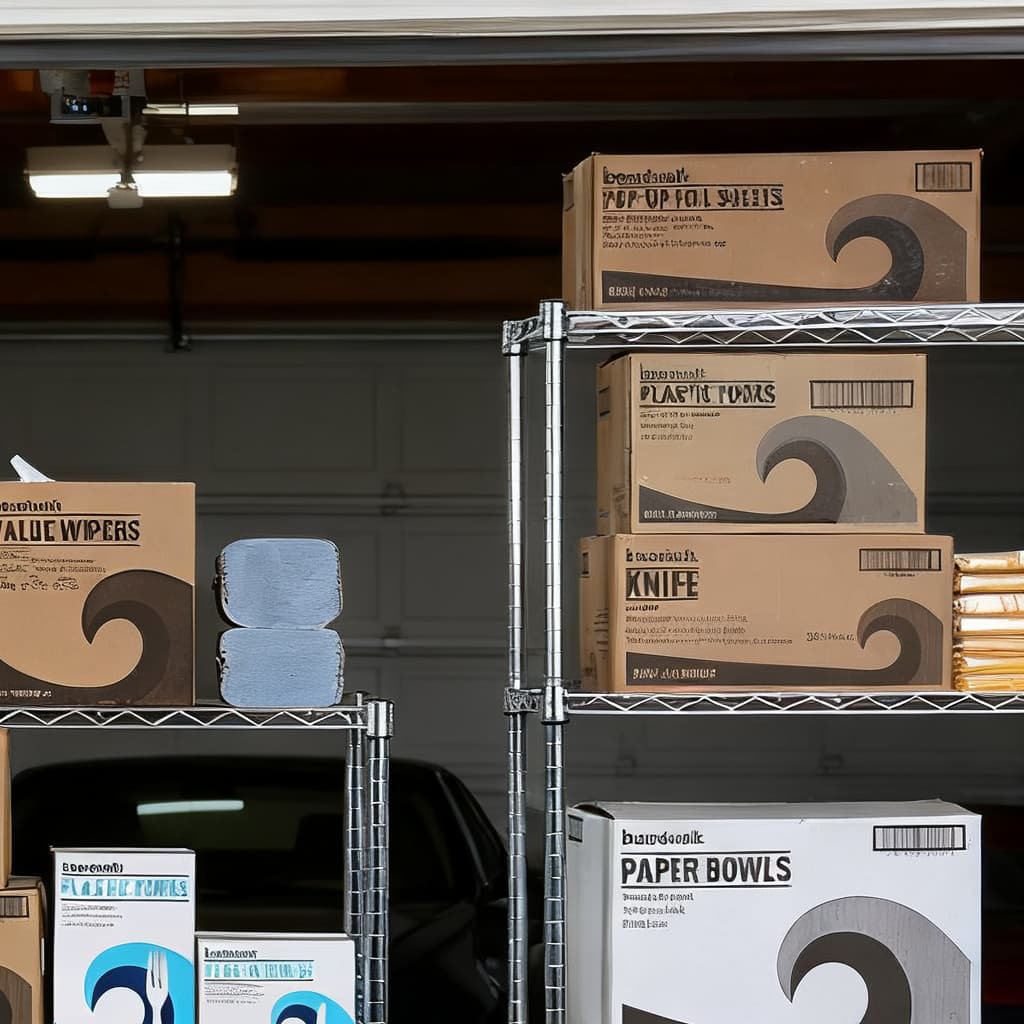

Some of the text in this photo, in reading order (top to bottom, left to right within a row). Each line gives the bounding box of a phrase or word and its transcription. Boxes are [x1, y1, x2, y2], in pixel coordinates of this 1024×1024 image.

[625, 570, 699, 598] KNIFE
[621, 855, 792, 884] PAPER BOWLS
